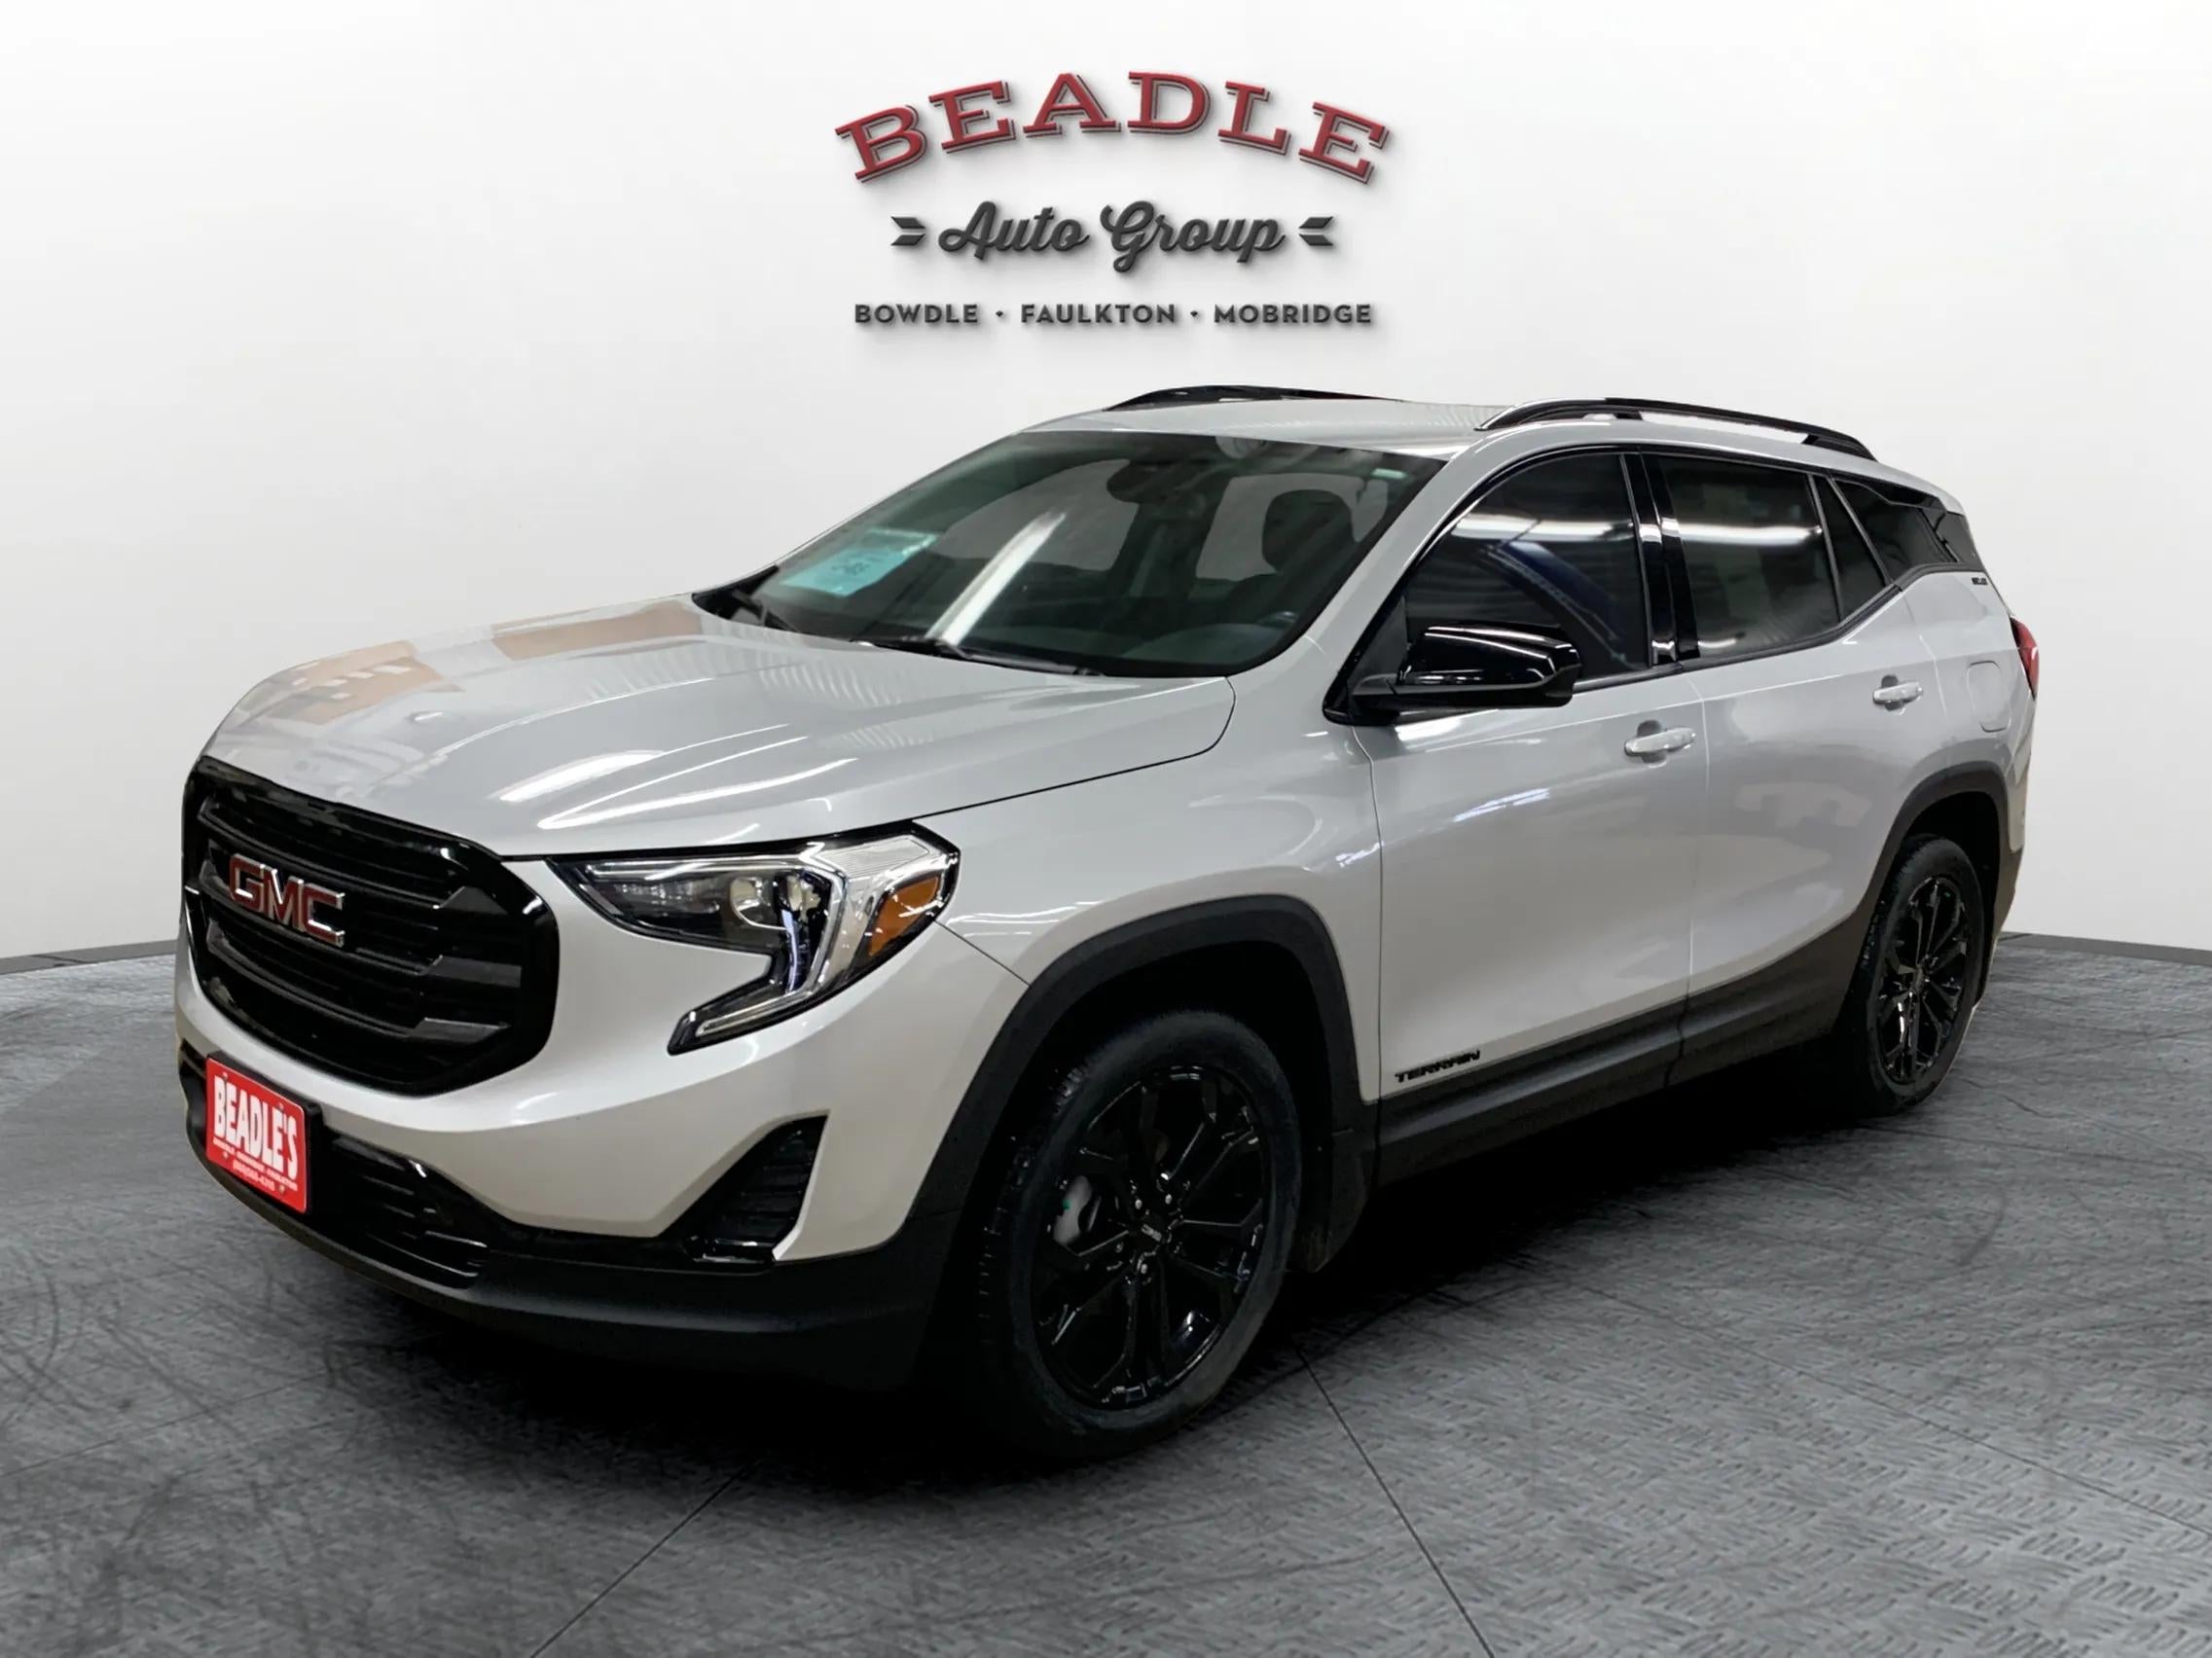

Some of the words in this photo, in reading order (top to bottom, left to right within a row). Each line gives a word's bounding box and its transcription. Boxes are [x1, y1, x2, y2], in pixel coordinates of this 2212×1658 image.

[835, 71, 1390, 185] BEADLE
[938, 200, 1089, 261] Auto
[1100, 200, 1286, 272] Group
[854, 304, 978, 324] BOWDLE
[1021, 304, 1176, 324] FAULKTON
[1214, 304, 1371, 324] MOBRIDGE
[230, 853, 345, 948] GMC
[1395, 1050, 1481, 1083] TERRAIN
[214, 1075, 299, 1181] BEADLE'S
